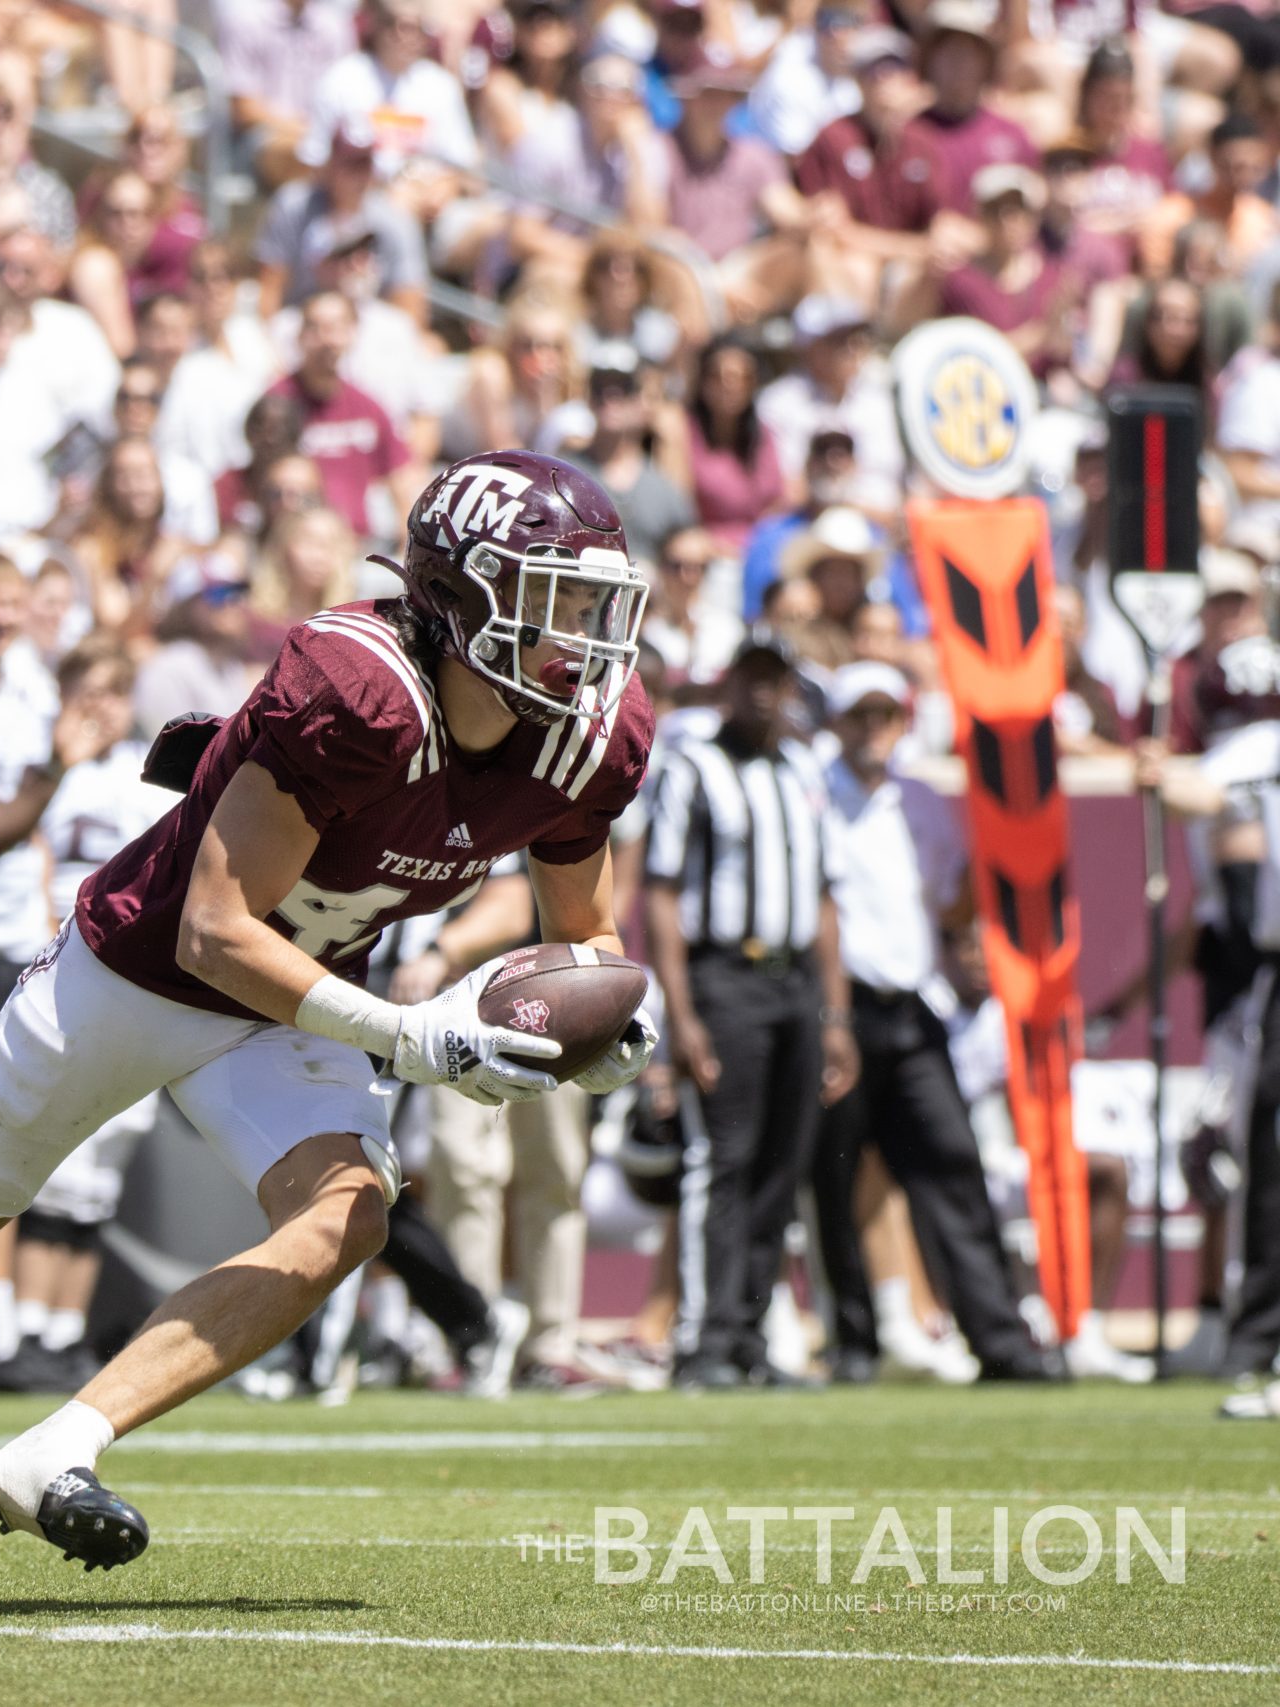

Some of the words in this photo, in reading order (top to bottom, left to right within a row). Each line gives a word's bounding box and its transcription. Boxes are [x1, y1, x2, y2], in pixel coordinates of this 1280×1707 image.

[445, 836, 474, 848] adidas
[376, 849, 457, 881] TEXAS
[445, 1030, 458, 1082] adidas
